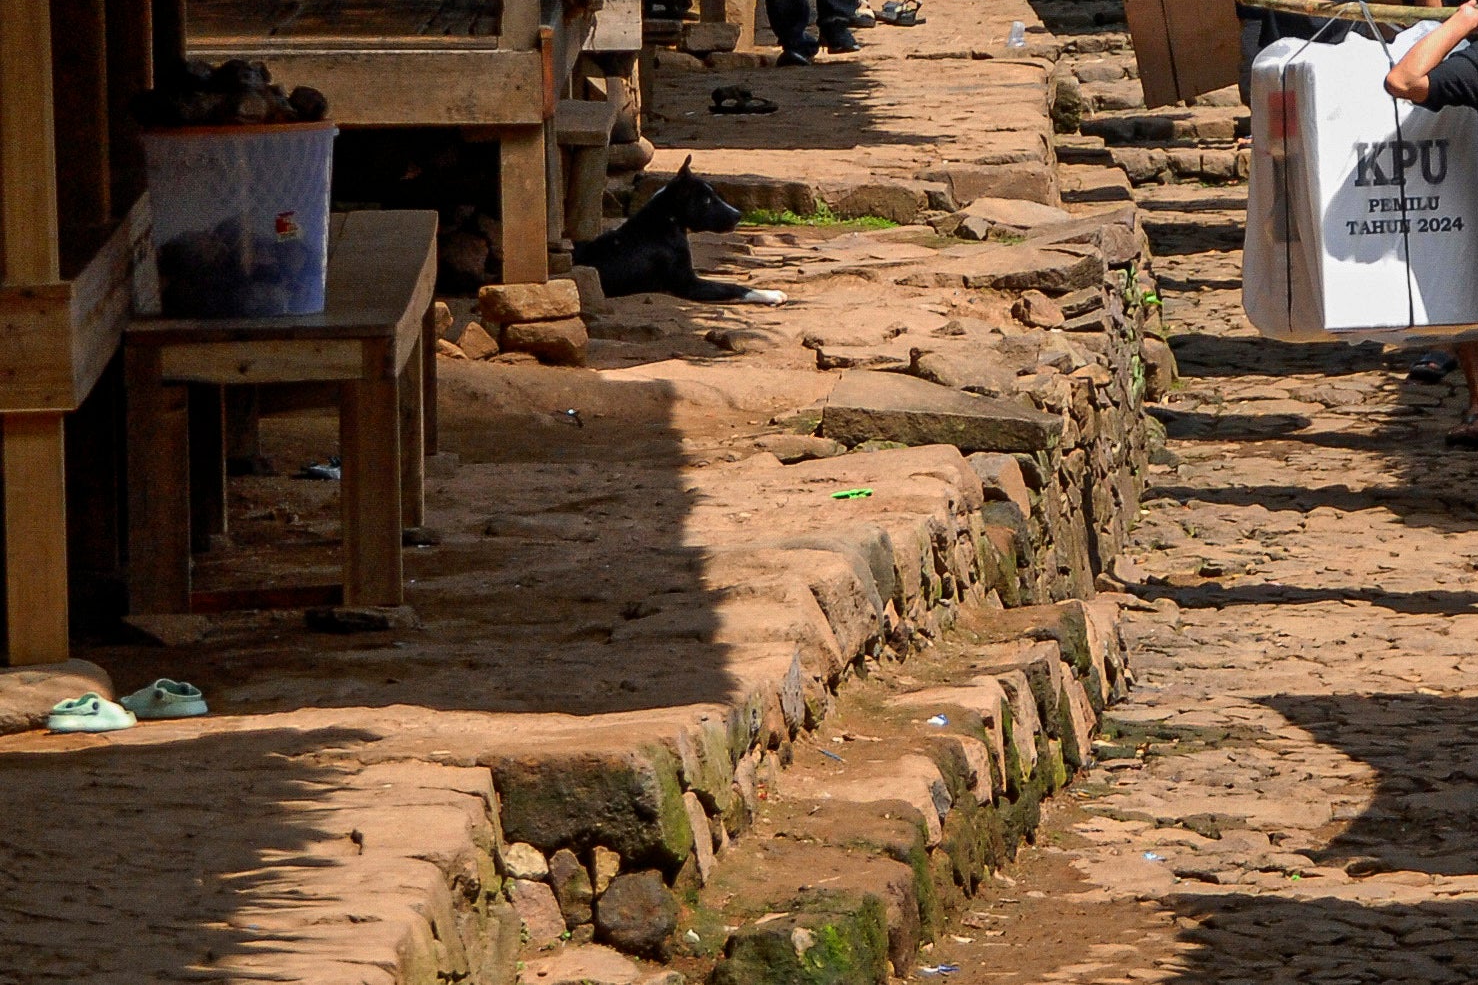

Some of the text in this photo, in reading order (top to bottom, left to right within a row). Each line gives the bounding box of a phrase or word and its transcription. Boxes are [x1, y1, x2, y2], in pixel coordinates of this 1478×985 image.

[1352, 139, 1449, 187] KPU
[1368, 196, 1440, 212] PEMILU
[1346, 216, 1464, 235] TAHUN 2024
